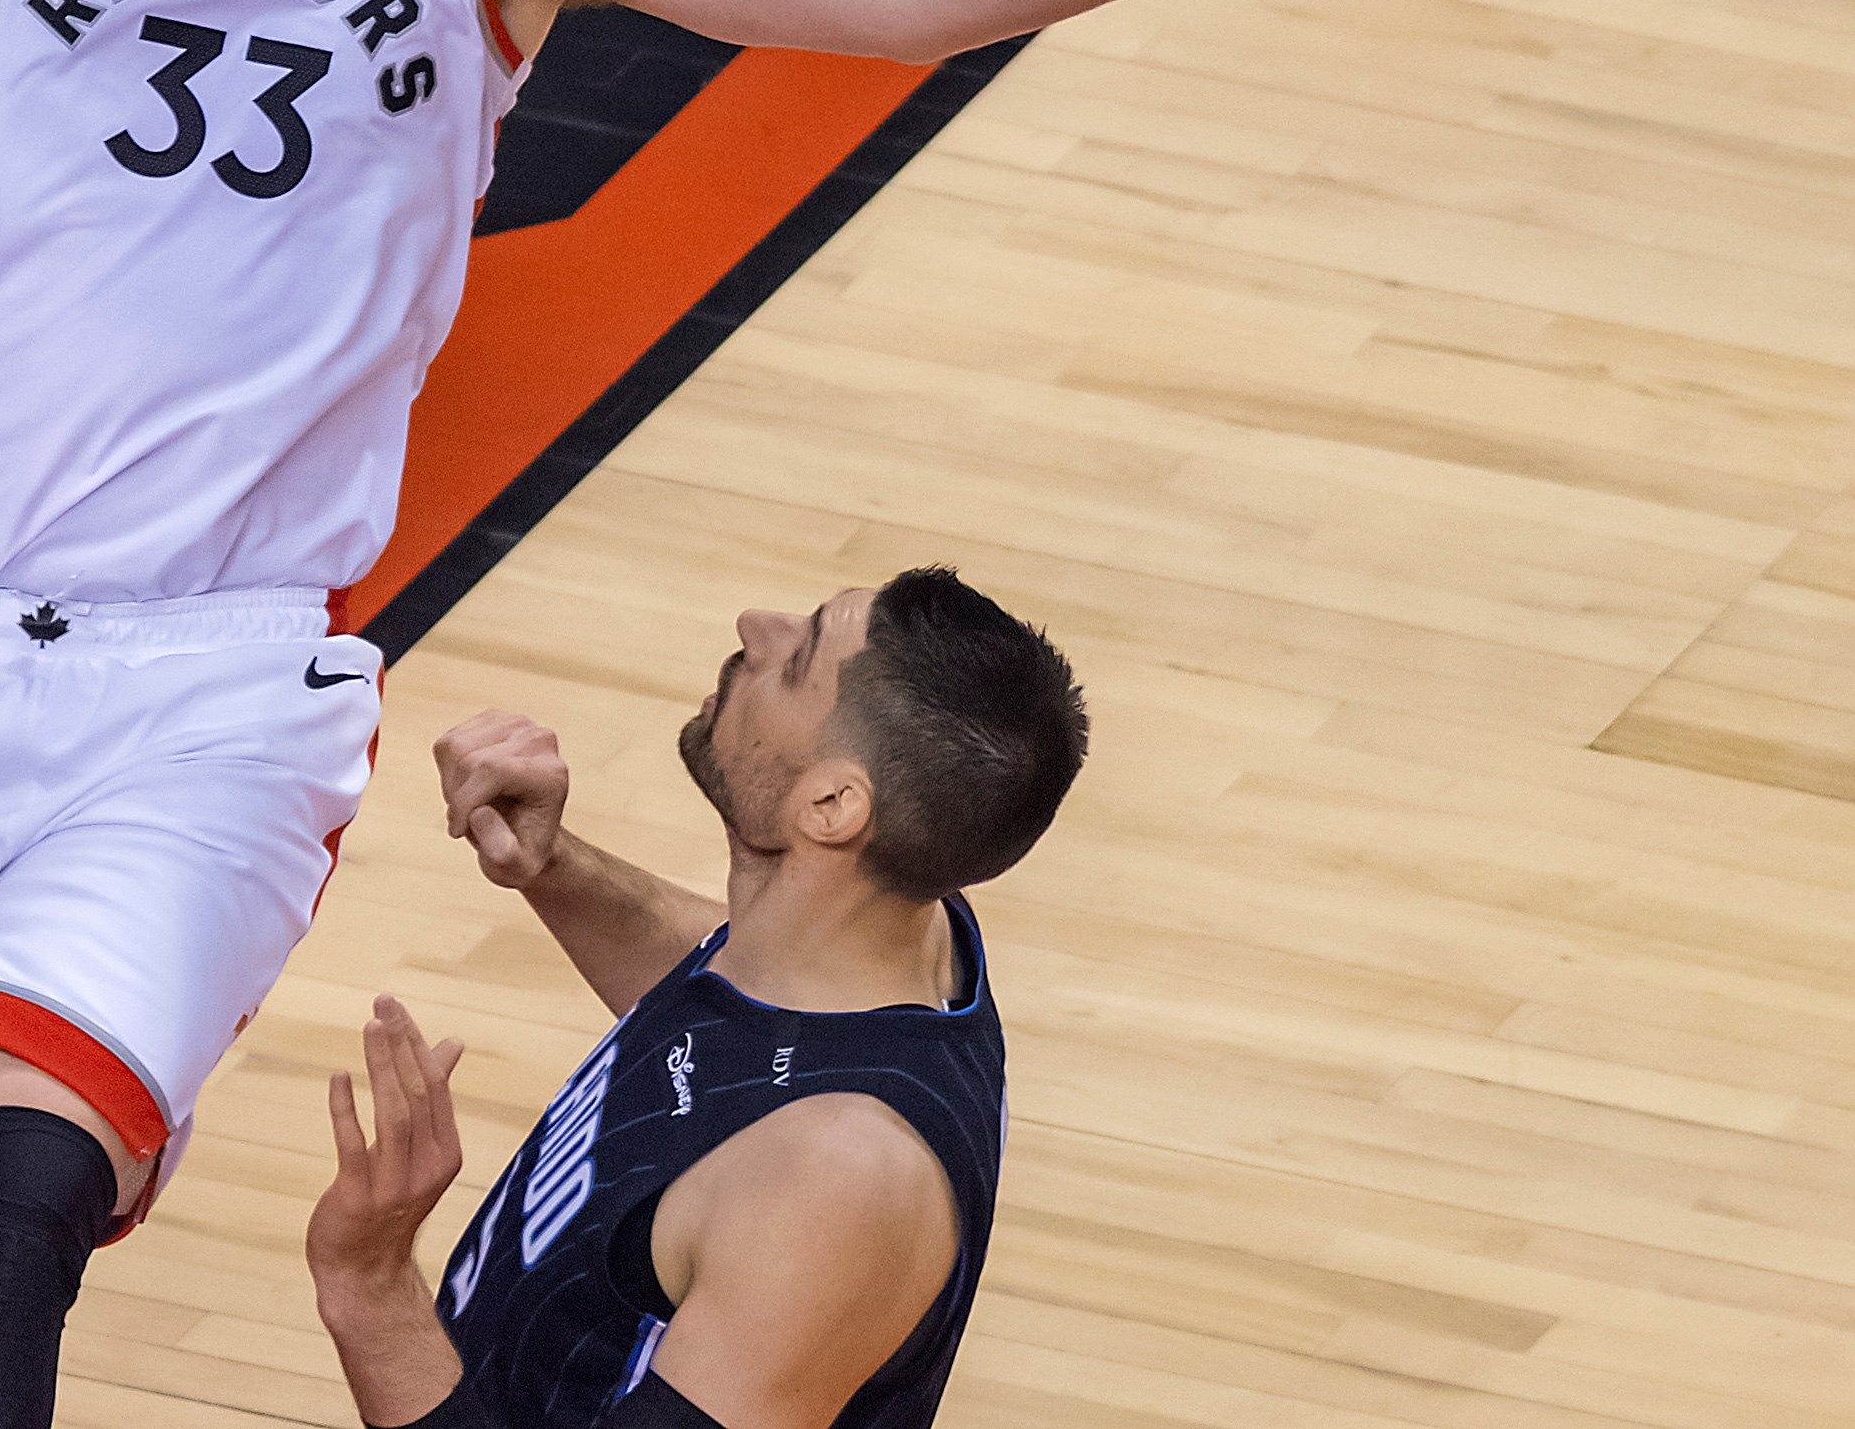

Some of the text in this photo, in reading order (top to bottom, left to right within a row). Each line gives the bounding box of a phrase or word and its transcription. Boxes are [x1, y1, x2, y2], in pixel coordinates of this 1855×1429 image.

[103, 13, 334, 200] 33
[666, 1032, 695, 1116] Disney
[771, 1045, 796, 1087] RDV
